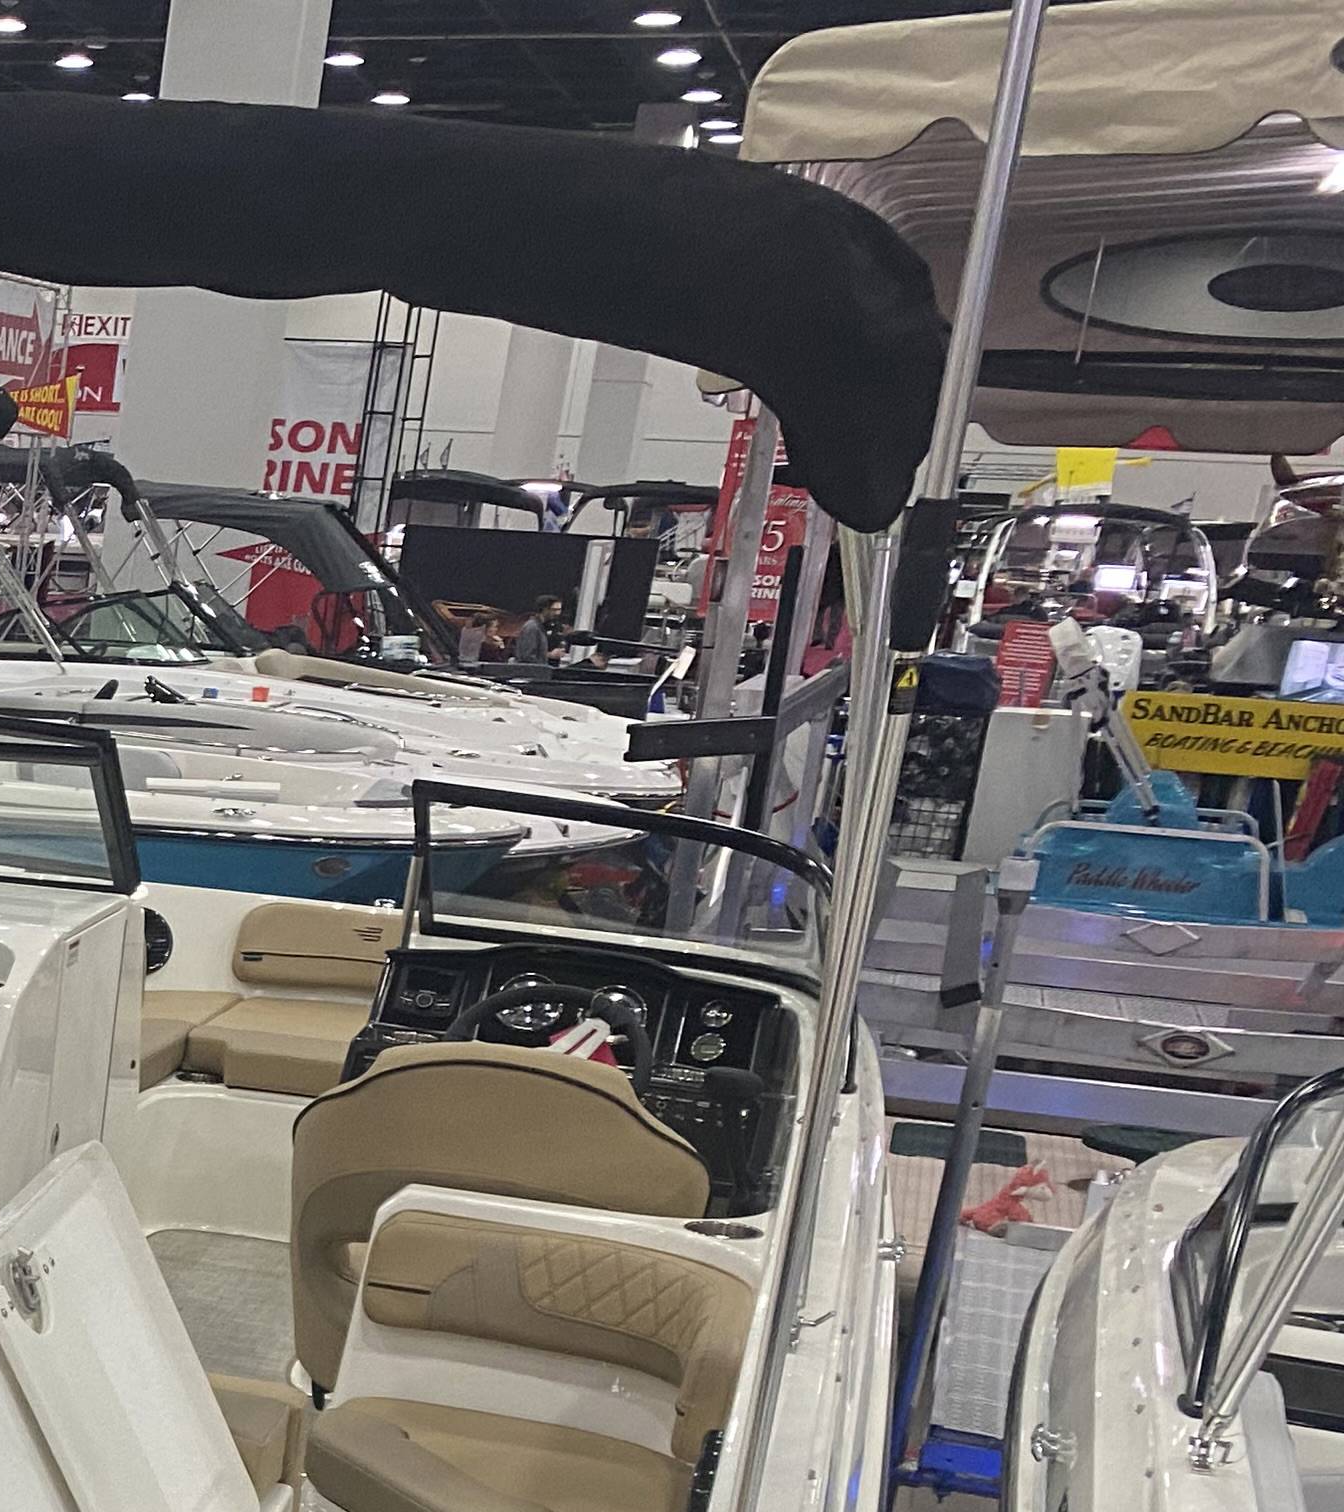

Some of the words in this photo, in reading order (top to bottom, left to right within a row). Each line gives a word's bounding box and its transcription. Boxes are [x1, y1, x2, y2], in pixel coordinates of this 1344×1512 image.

[84, 315, 132, 337] EXIT
[1145, 732, 1234, 751] BOATING
[1253, 741, 1344, 760] BEAC
[1065, 862, 1129, 888] Paddle
[1131, 864, 1202, 894] Wheeler
